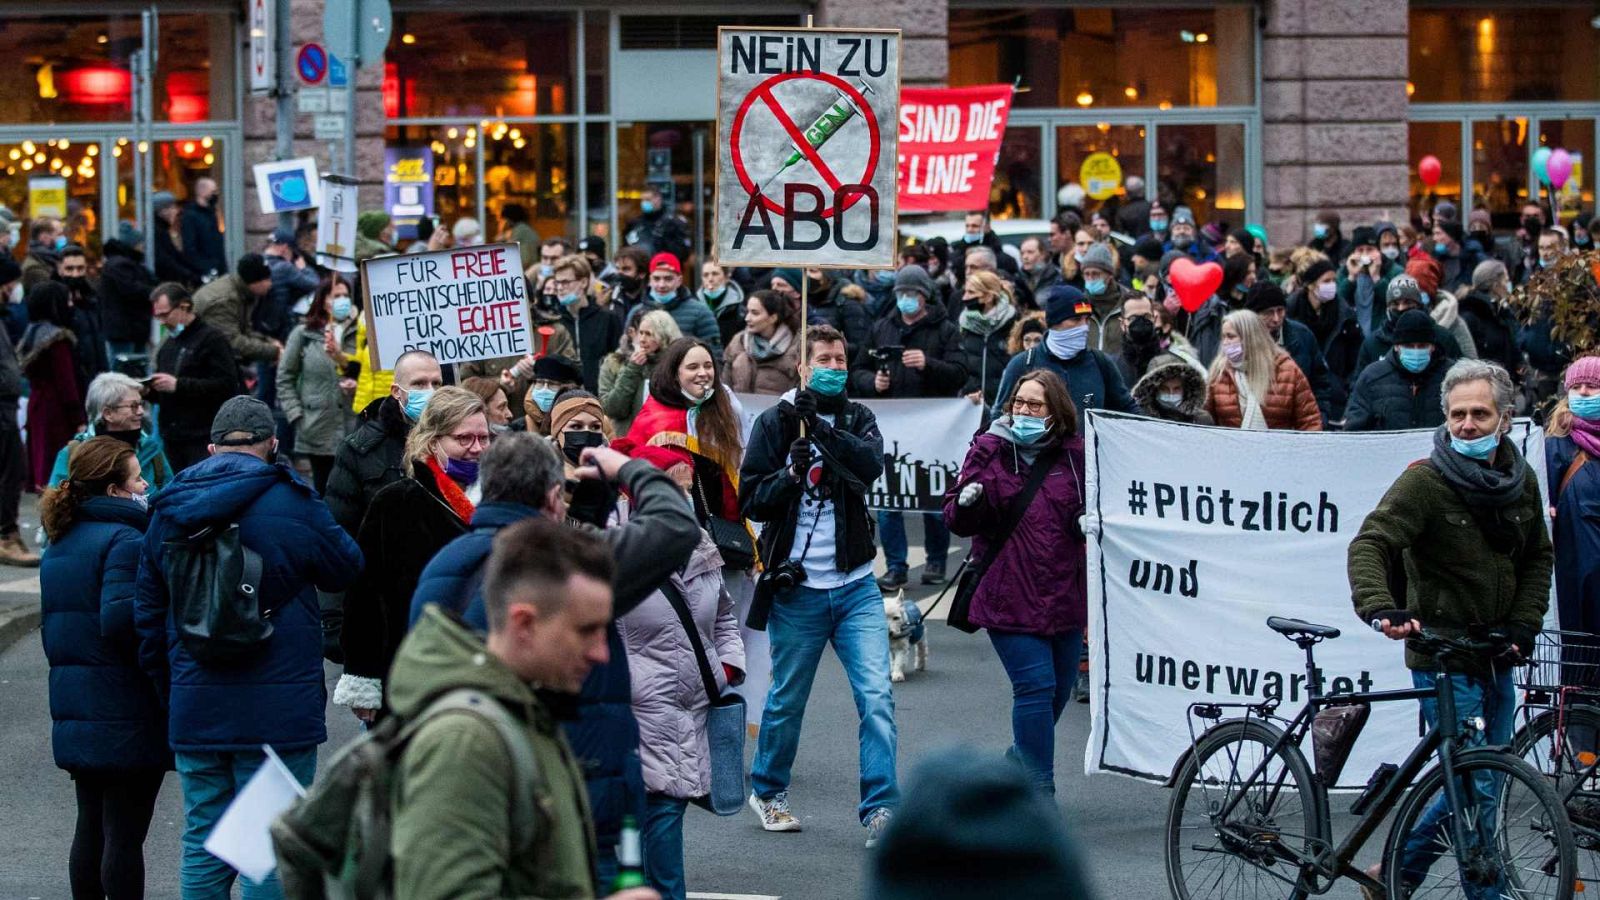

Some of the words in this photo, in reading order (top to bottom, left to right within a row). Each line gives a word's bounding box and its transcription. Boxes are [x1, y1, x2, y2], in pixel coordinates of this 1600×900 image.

[837, 38, 888, 77] ZU
[806, 103, 850, 145] GEN
[899, 103, 961, 143] SIND
[965, 98, 1006, 142] DIE
[907, 153, 978, 194] LINIE
[732, 182, 879, 251] ABO
[397, 257, 441, 284] FÜR
[451, 248, 507, 279] FREIE
[373, 276, 525, 317] IMPFENTSCHEIDUNG
[404, 313, 446, 341] FÜR
[457, 301, 522, 335] ECHTE
[1128, 480, 1338, 533] #Plötzlich
[1129, 560, 1198, 598] und
